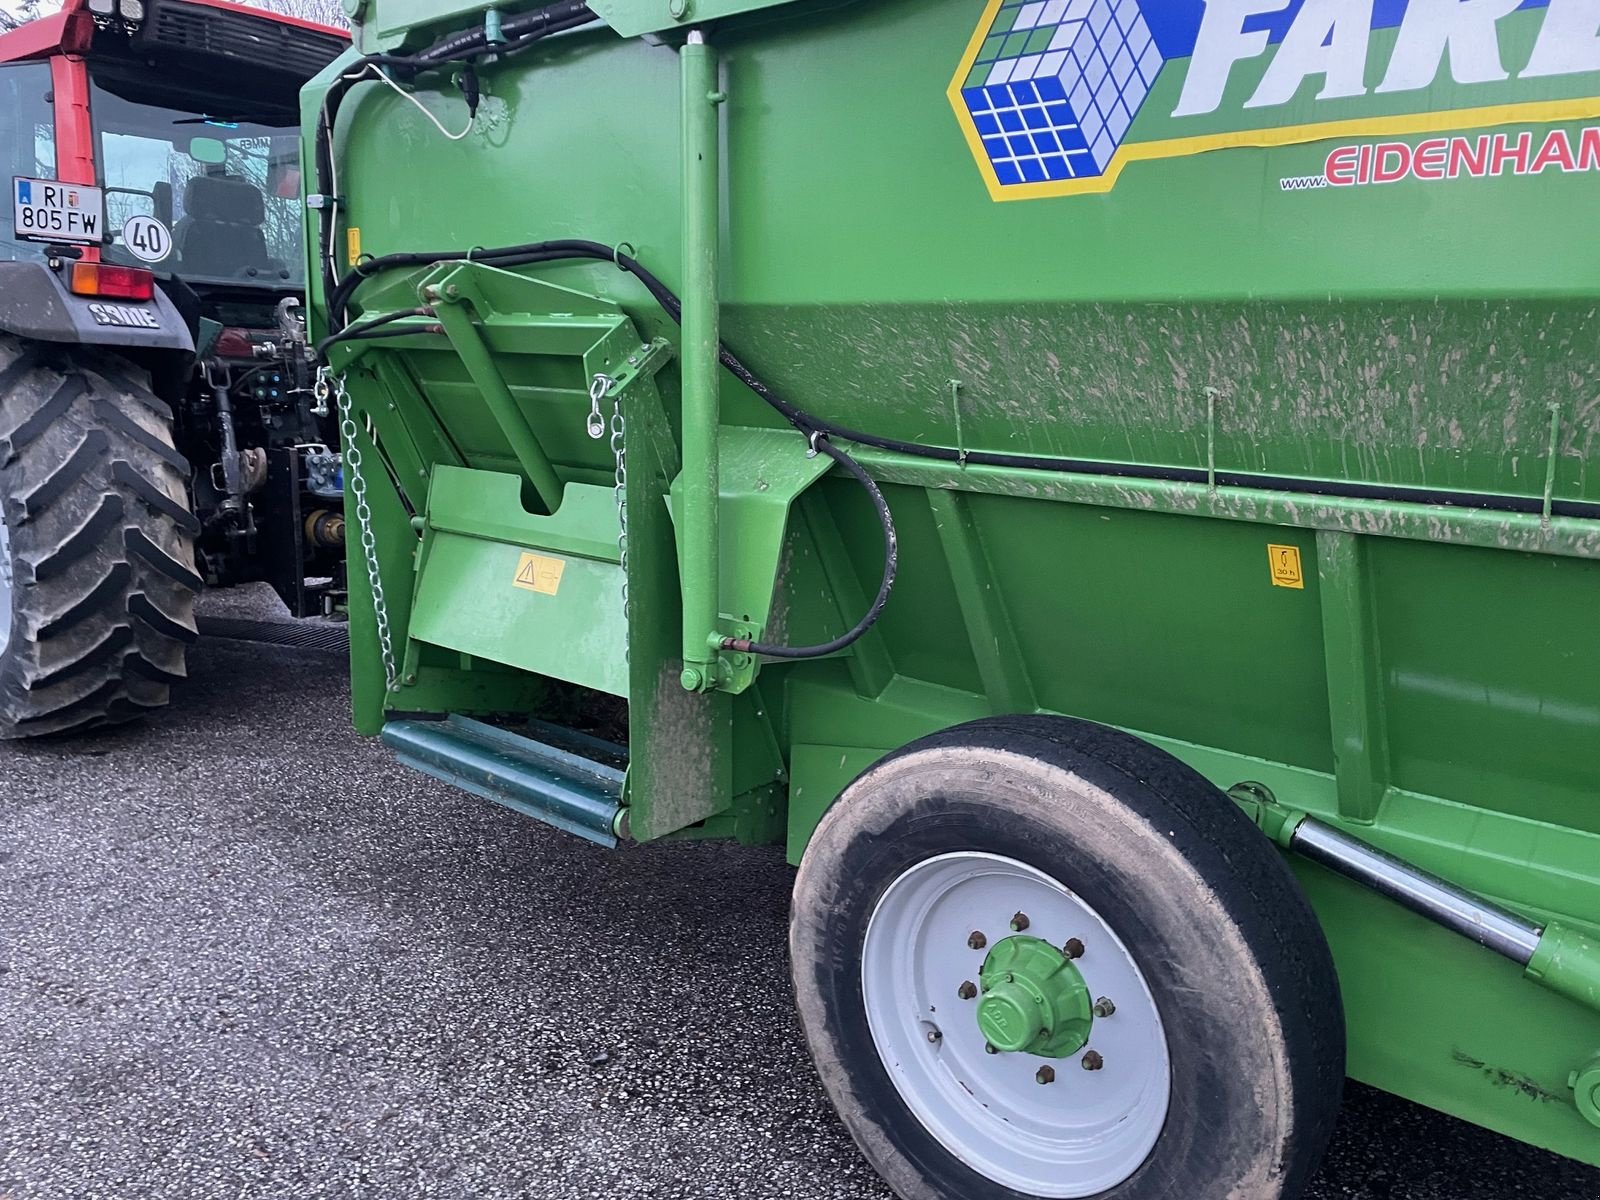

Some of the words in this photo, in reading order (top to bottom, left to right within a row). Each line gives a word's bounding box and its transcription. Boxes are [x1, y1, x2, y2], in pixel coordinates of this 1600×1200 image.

[44, 186, 64, 209] RI
[133, 222, 161, 253] 40
[88, 304, 160, 329] SAME
